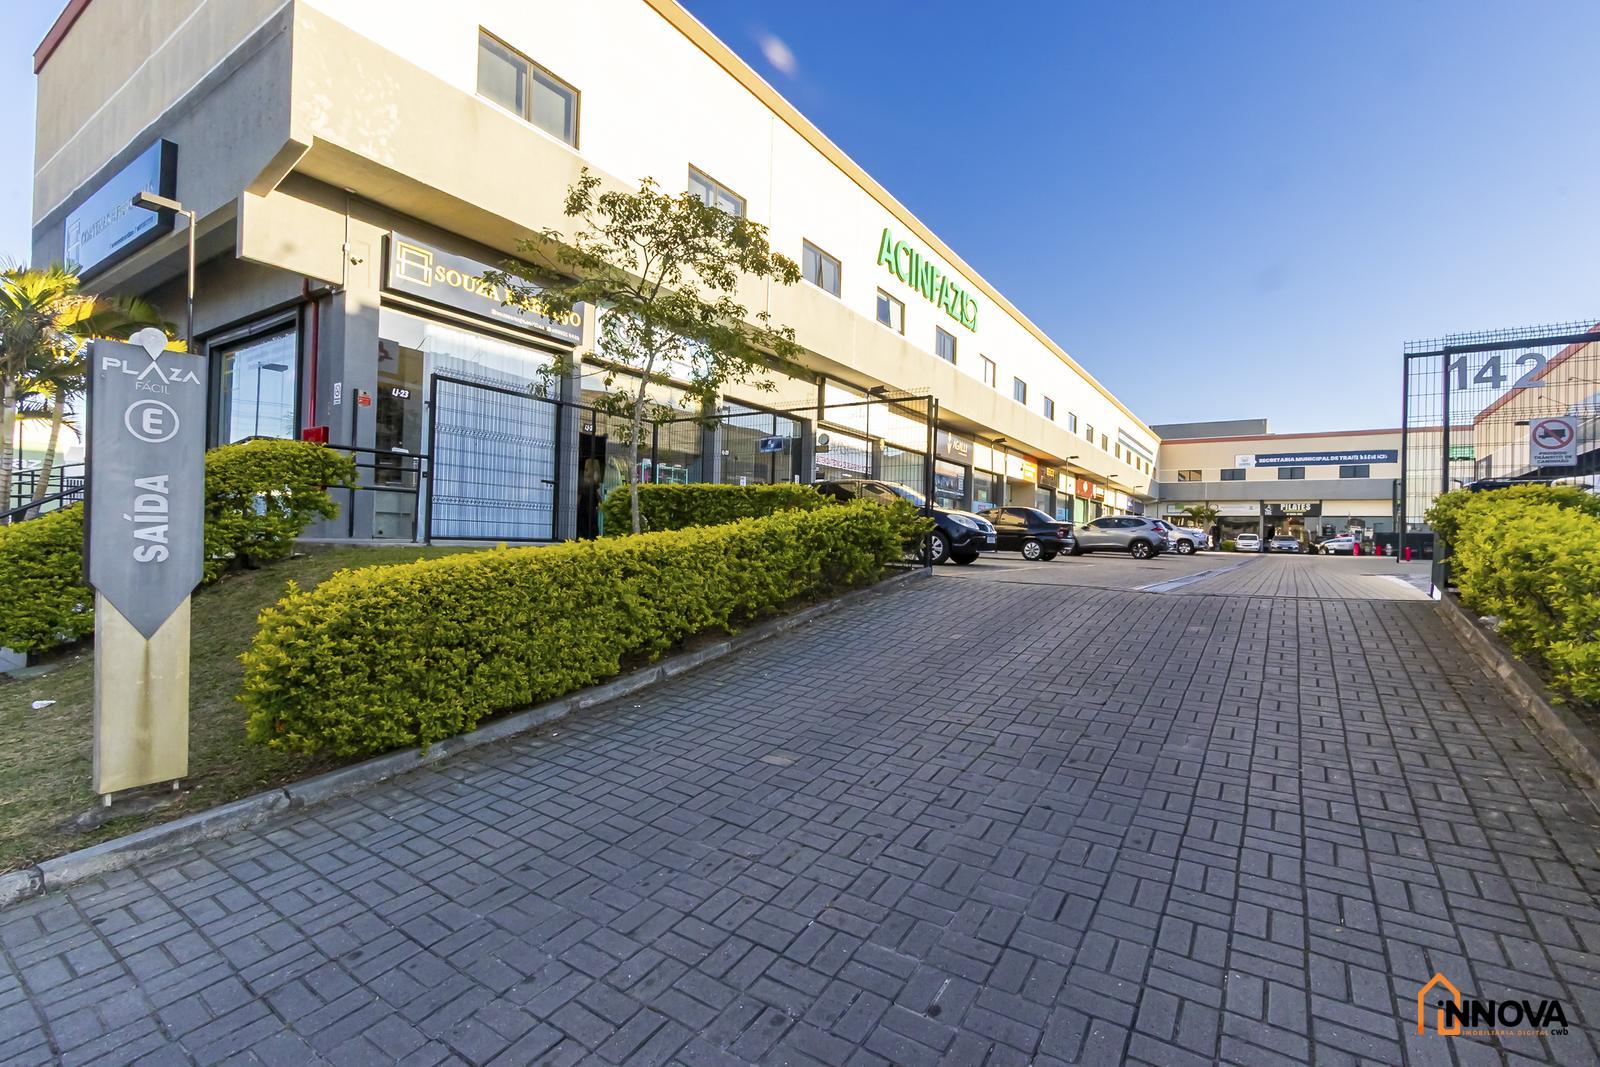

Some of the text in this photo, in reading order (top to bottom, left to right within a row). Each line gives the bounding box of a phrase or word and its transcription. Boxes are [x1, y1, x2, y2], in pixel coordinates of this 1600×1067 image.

[434, 265, 500, 301] SOUZA
[102, 356, 200, 385] PLAZA
[1448, 352, 1546, 390] 142
[135, 380, 170, 395] FÁCIL
[123, 474, 170, 564] SAÍDA
[1280, 503, 1311, 511] PILATES
